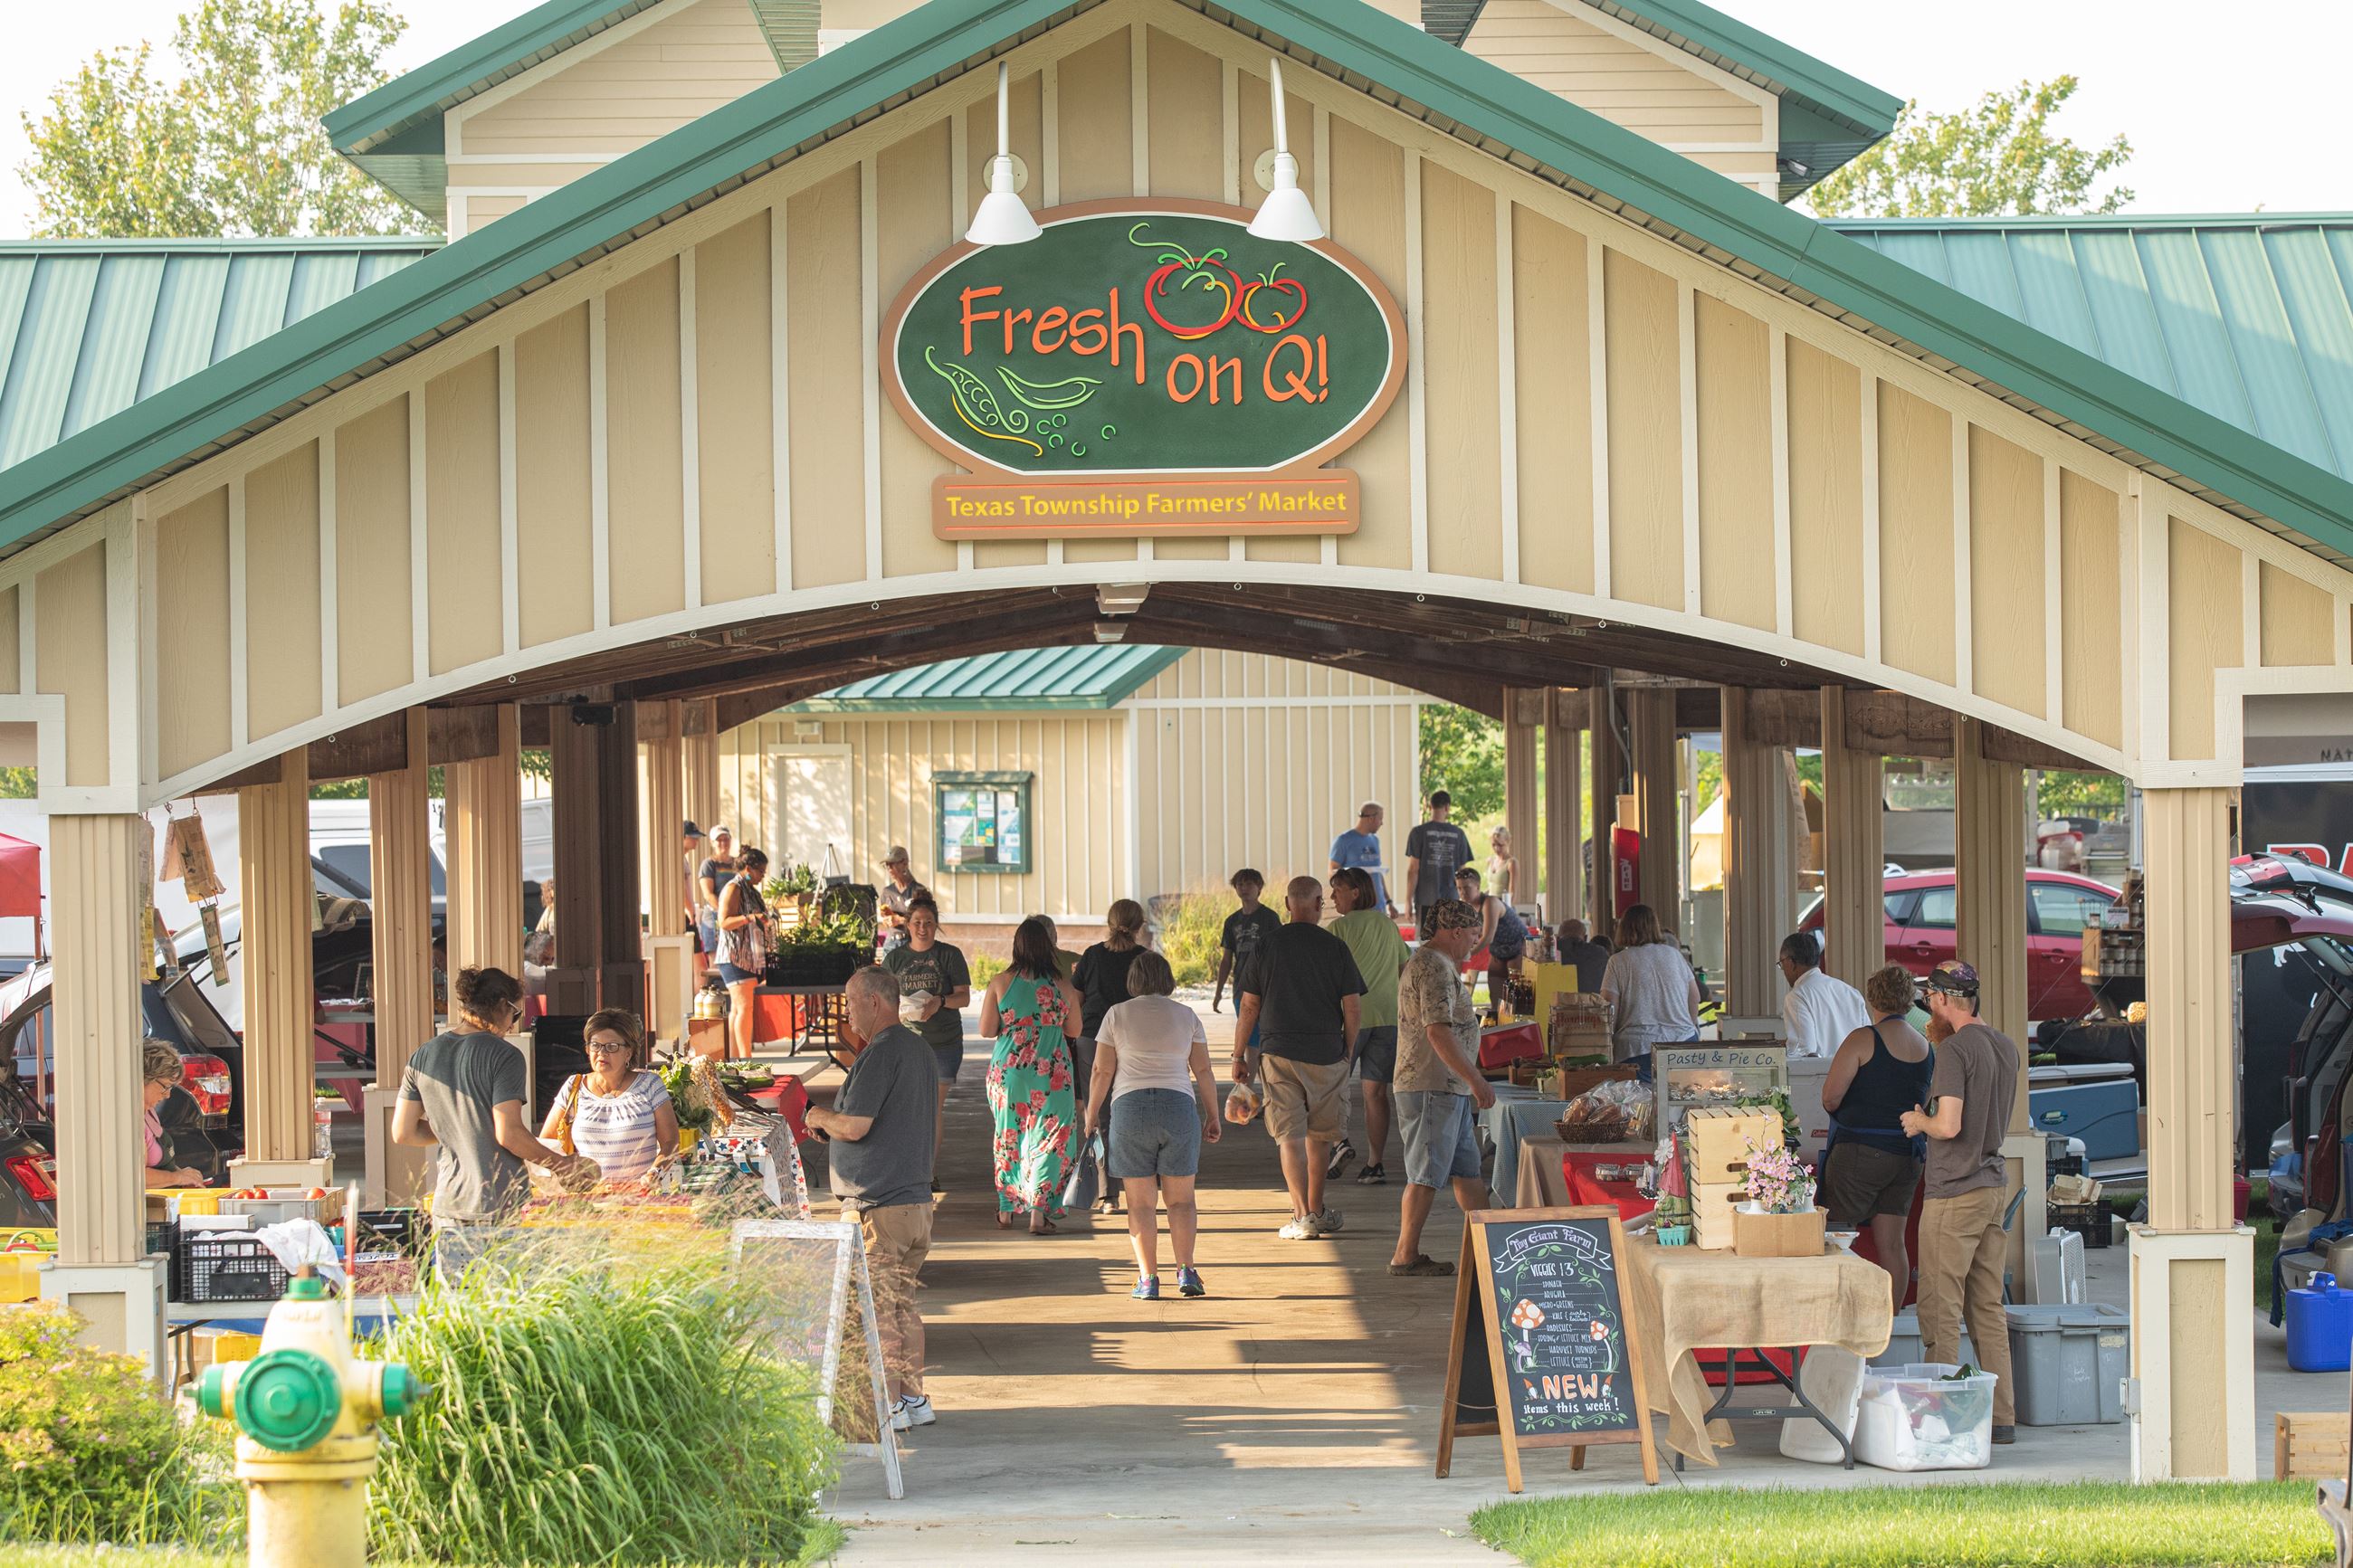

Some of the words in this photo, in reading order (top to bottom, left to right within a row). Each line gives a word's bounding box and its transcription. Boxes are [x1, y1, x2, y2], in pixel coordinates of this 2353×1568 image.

[959, 285, 1146, 385] Fresh
[1166, 353, 1243, 405] on
[1262, 333, 1330, 404] Q!
[946, 495, 1015, 518] Texas
[1020, 494, 1140, 519] Township
[1147, 491, 1254, 514] Farmers'
[1258, 490, 1348, 513] Market
[904, 980, 938, 991] MARKET
[1667, 1052, 1707, 1066] Pasty
[1711, 1050, 1724, 1063] &
[1729, 1052, 1750, 1065] Pie
[1755, 1052, 1777, 1066] Co.
[1510, 1239, 1529, 1254] Tiny
[1529, 1231, 1558, 1244] Giant
[1562, 1228, 1593, 1250] Farm
[1541, 1373, 1598, 1400] NEW
[1523, 1404, 1549, 1414] items
[1556, 1402, 1580, 1414] this
